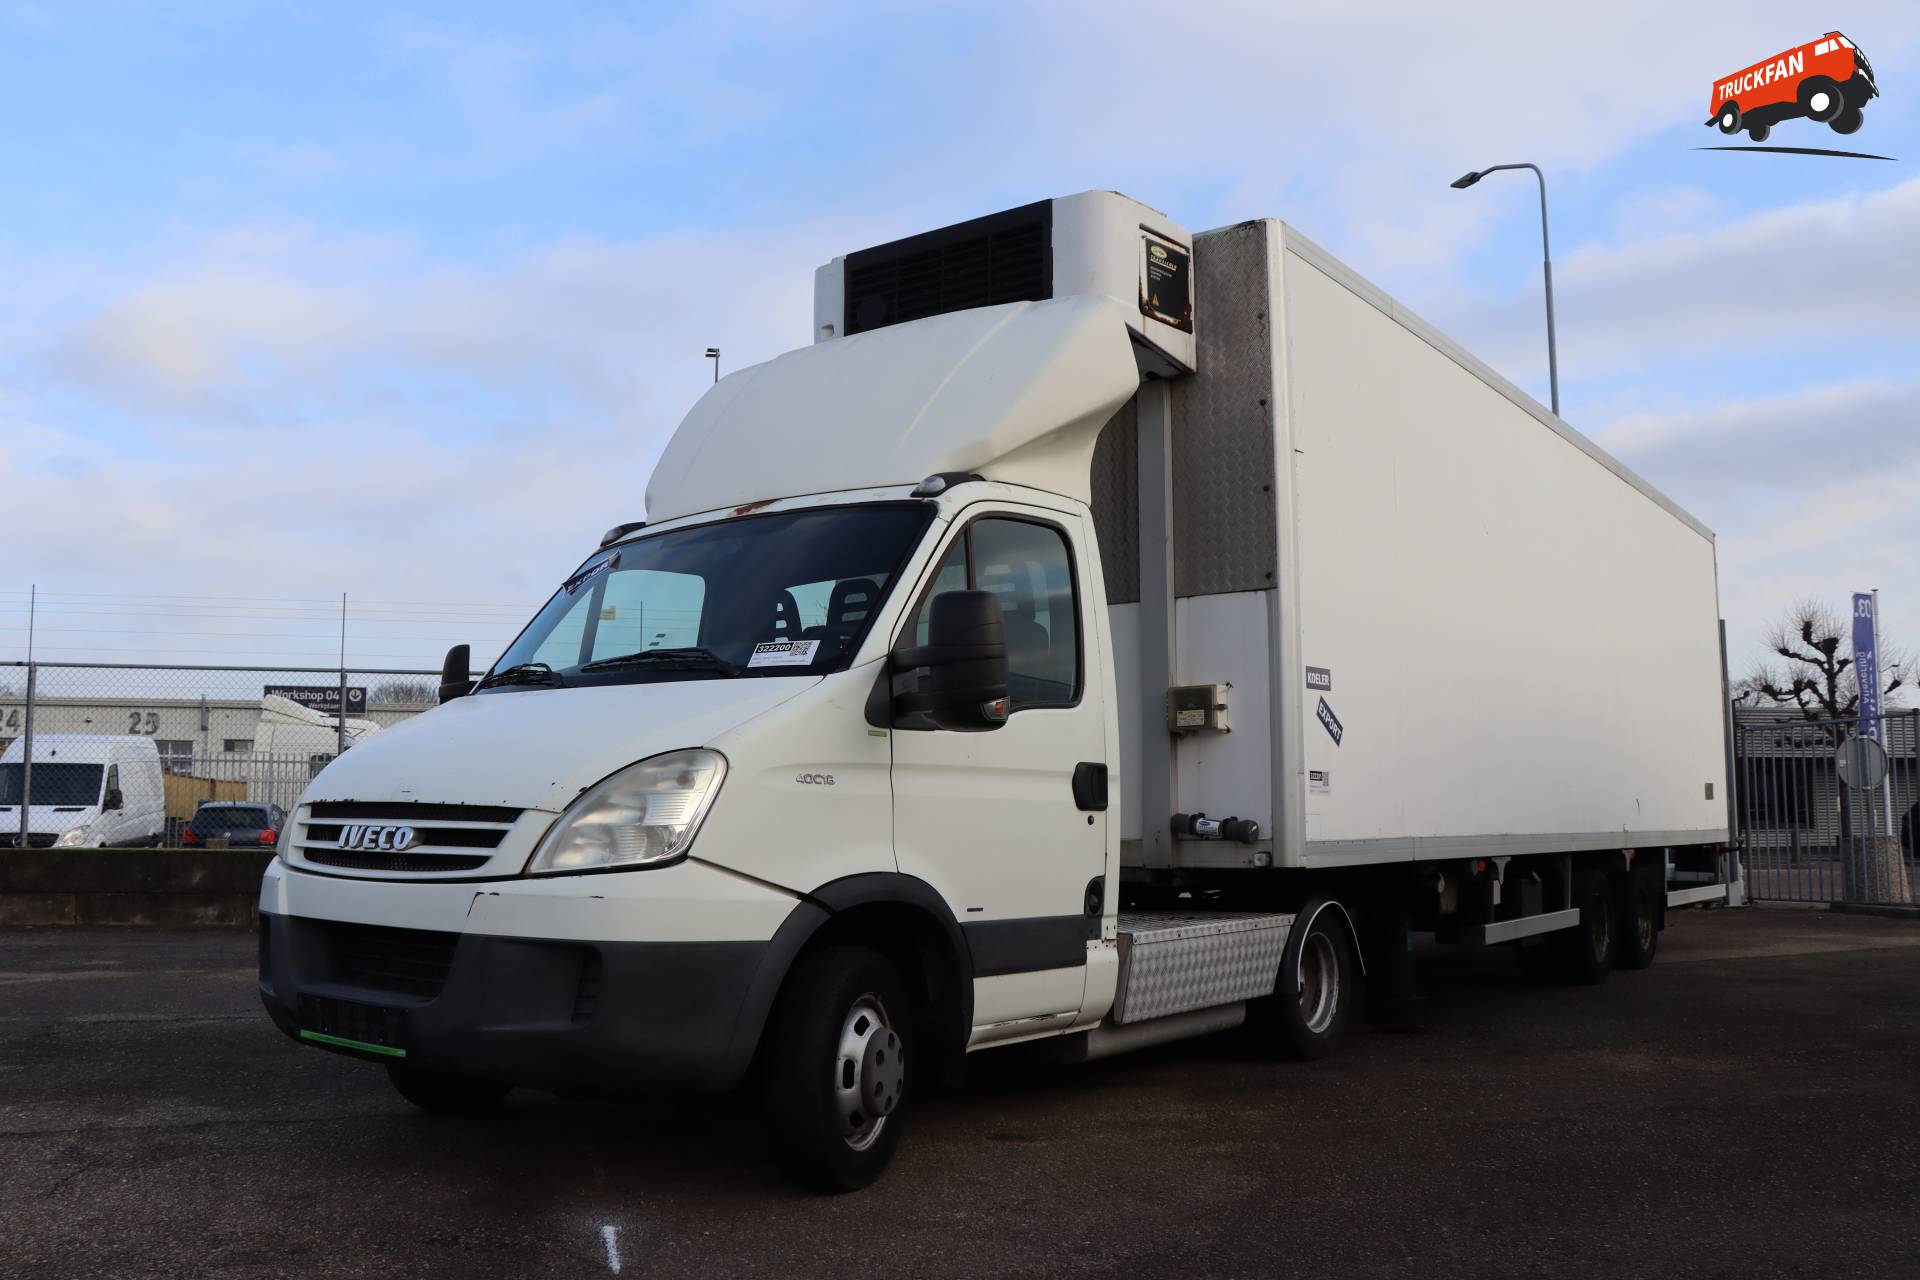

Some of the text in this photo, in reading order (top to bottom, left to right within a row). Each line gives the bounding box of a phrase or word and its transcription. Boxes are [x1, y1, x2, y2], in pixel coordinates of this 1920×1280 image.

[757, 643, 791, 654] 322200
[1307, 671, 1330, 686] KOELER
[271, 689, 340, 701] Workshop 04
[1318, 702, 1342, 740] EXPORT
[337, 825, 415, 851] IVECO
